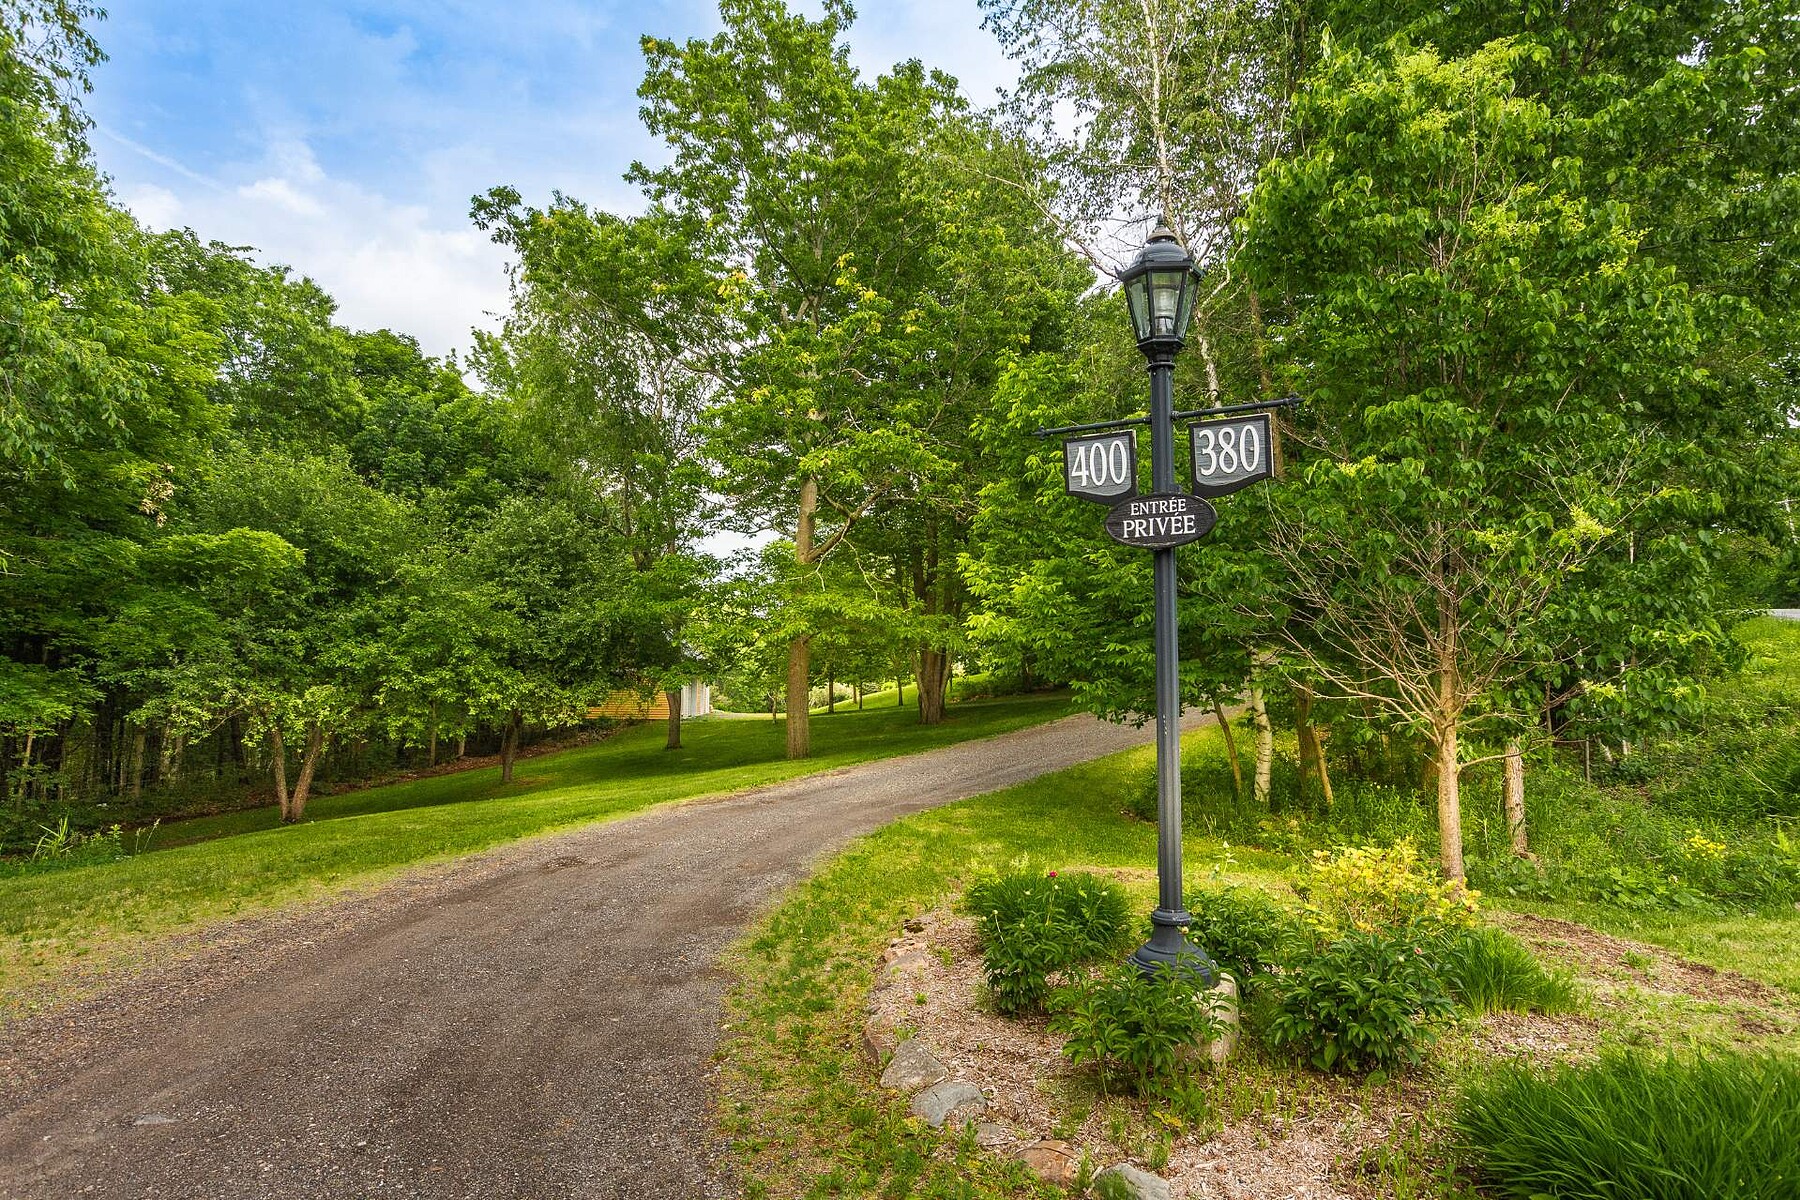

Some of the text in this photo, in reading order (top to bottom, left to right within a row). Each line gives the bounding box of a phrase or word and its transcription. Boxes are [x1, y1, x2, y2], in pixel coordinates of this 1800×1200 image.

[1071, 440, 1128, 487] 400
[1199, 424, 1260, 476] 380
[1130, 497, 1187, 516] ENTRÉE
[1123, 513, 1196, 539] PRIVÉE
